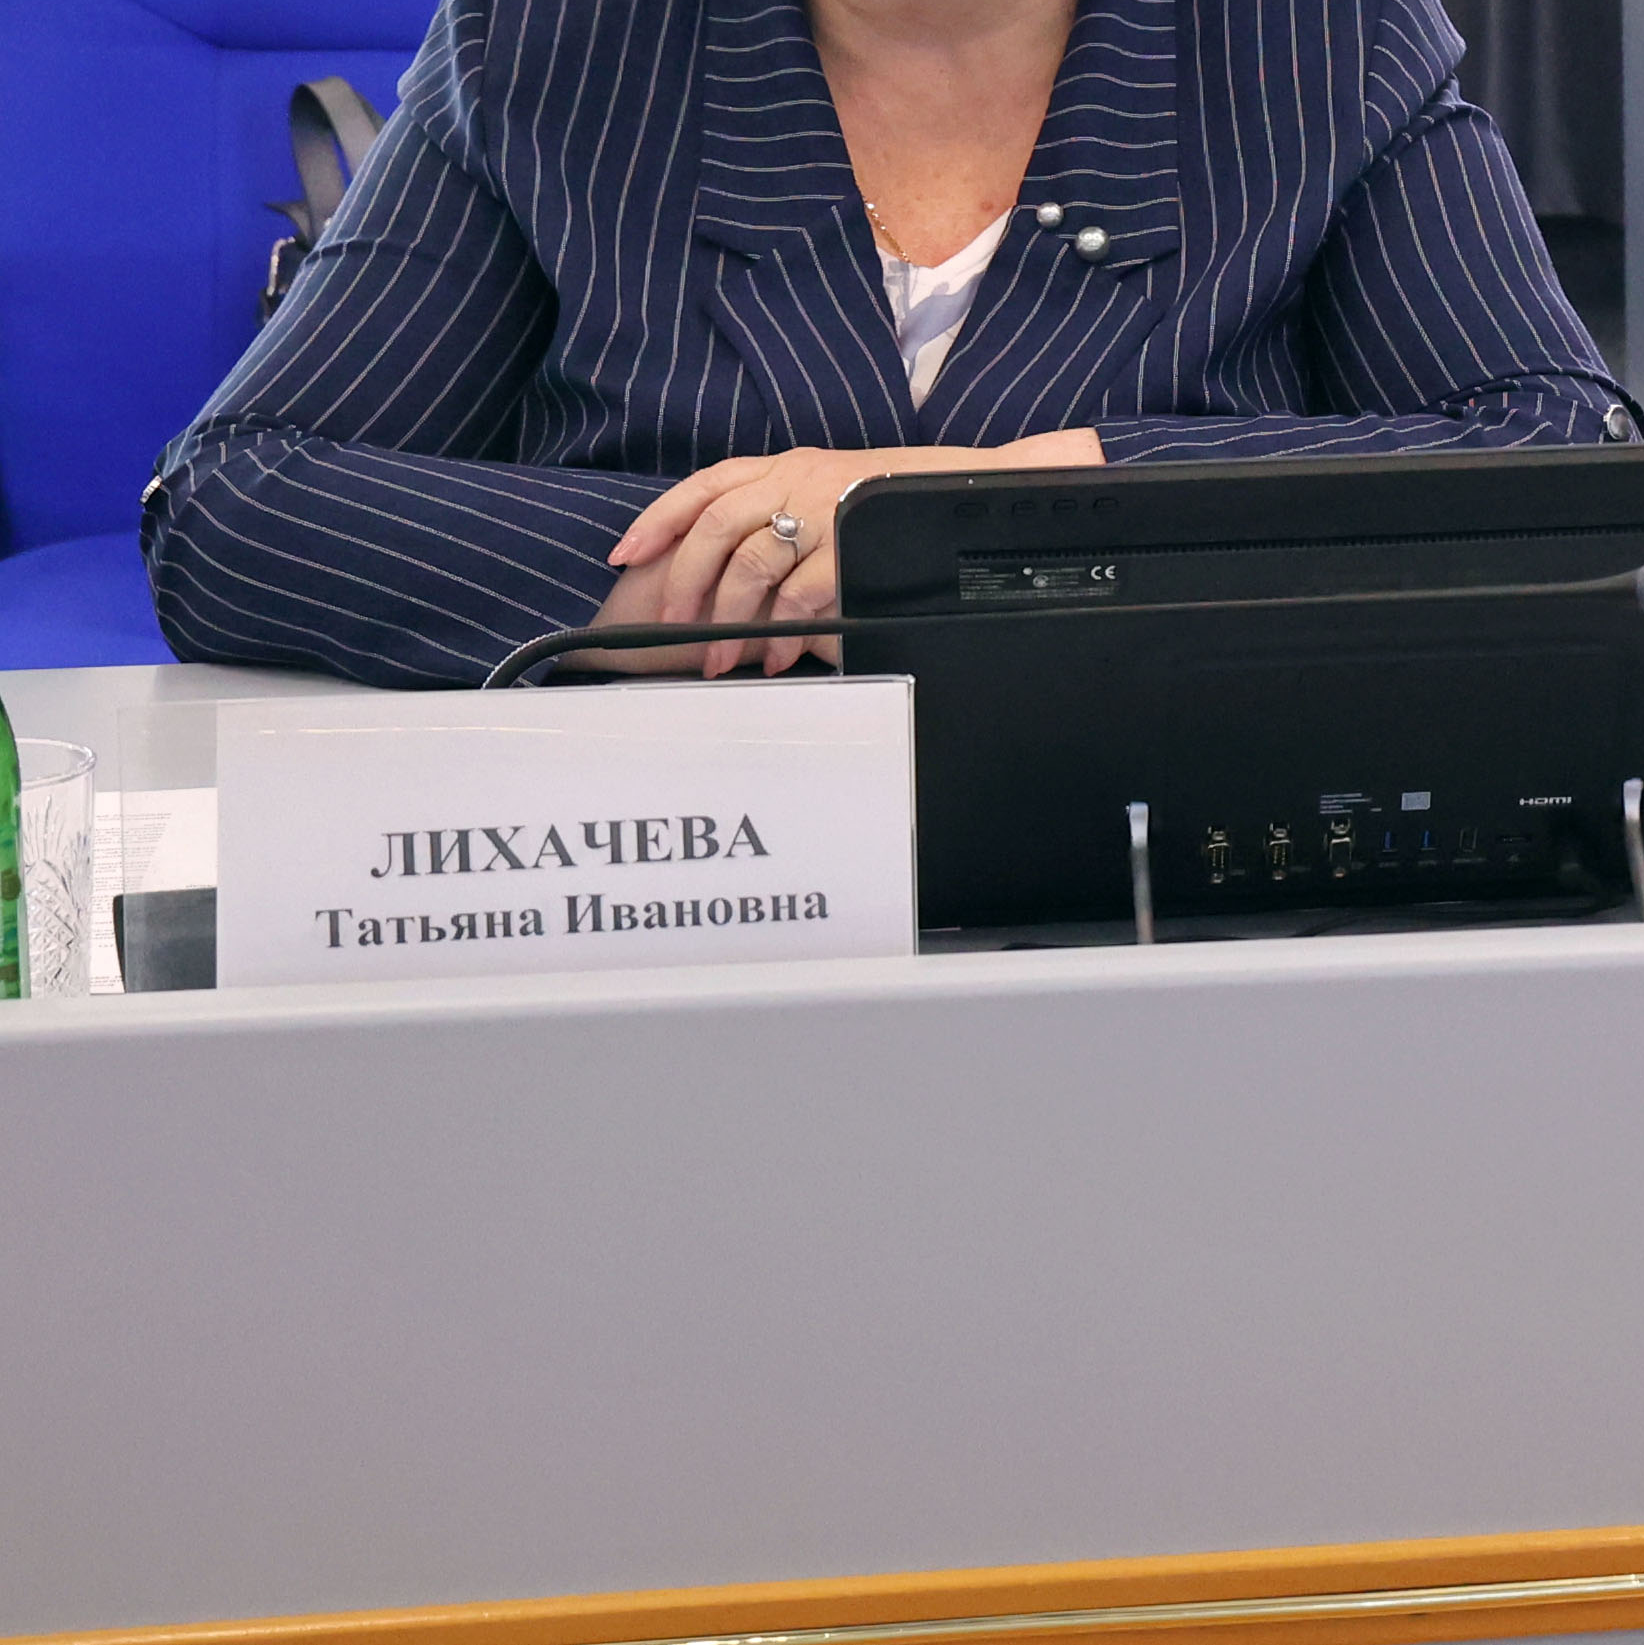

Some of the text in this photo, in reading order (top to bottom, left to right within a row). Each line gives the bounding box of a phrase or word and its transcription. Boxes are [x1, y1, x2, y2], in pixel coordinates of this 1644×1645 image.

[1518, 795, 1573, 807] HDMI
[369, 813, 770, 879] ЛИХАЧЕВА
[315, 890, 830, 949] Татьяна Ивановна
